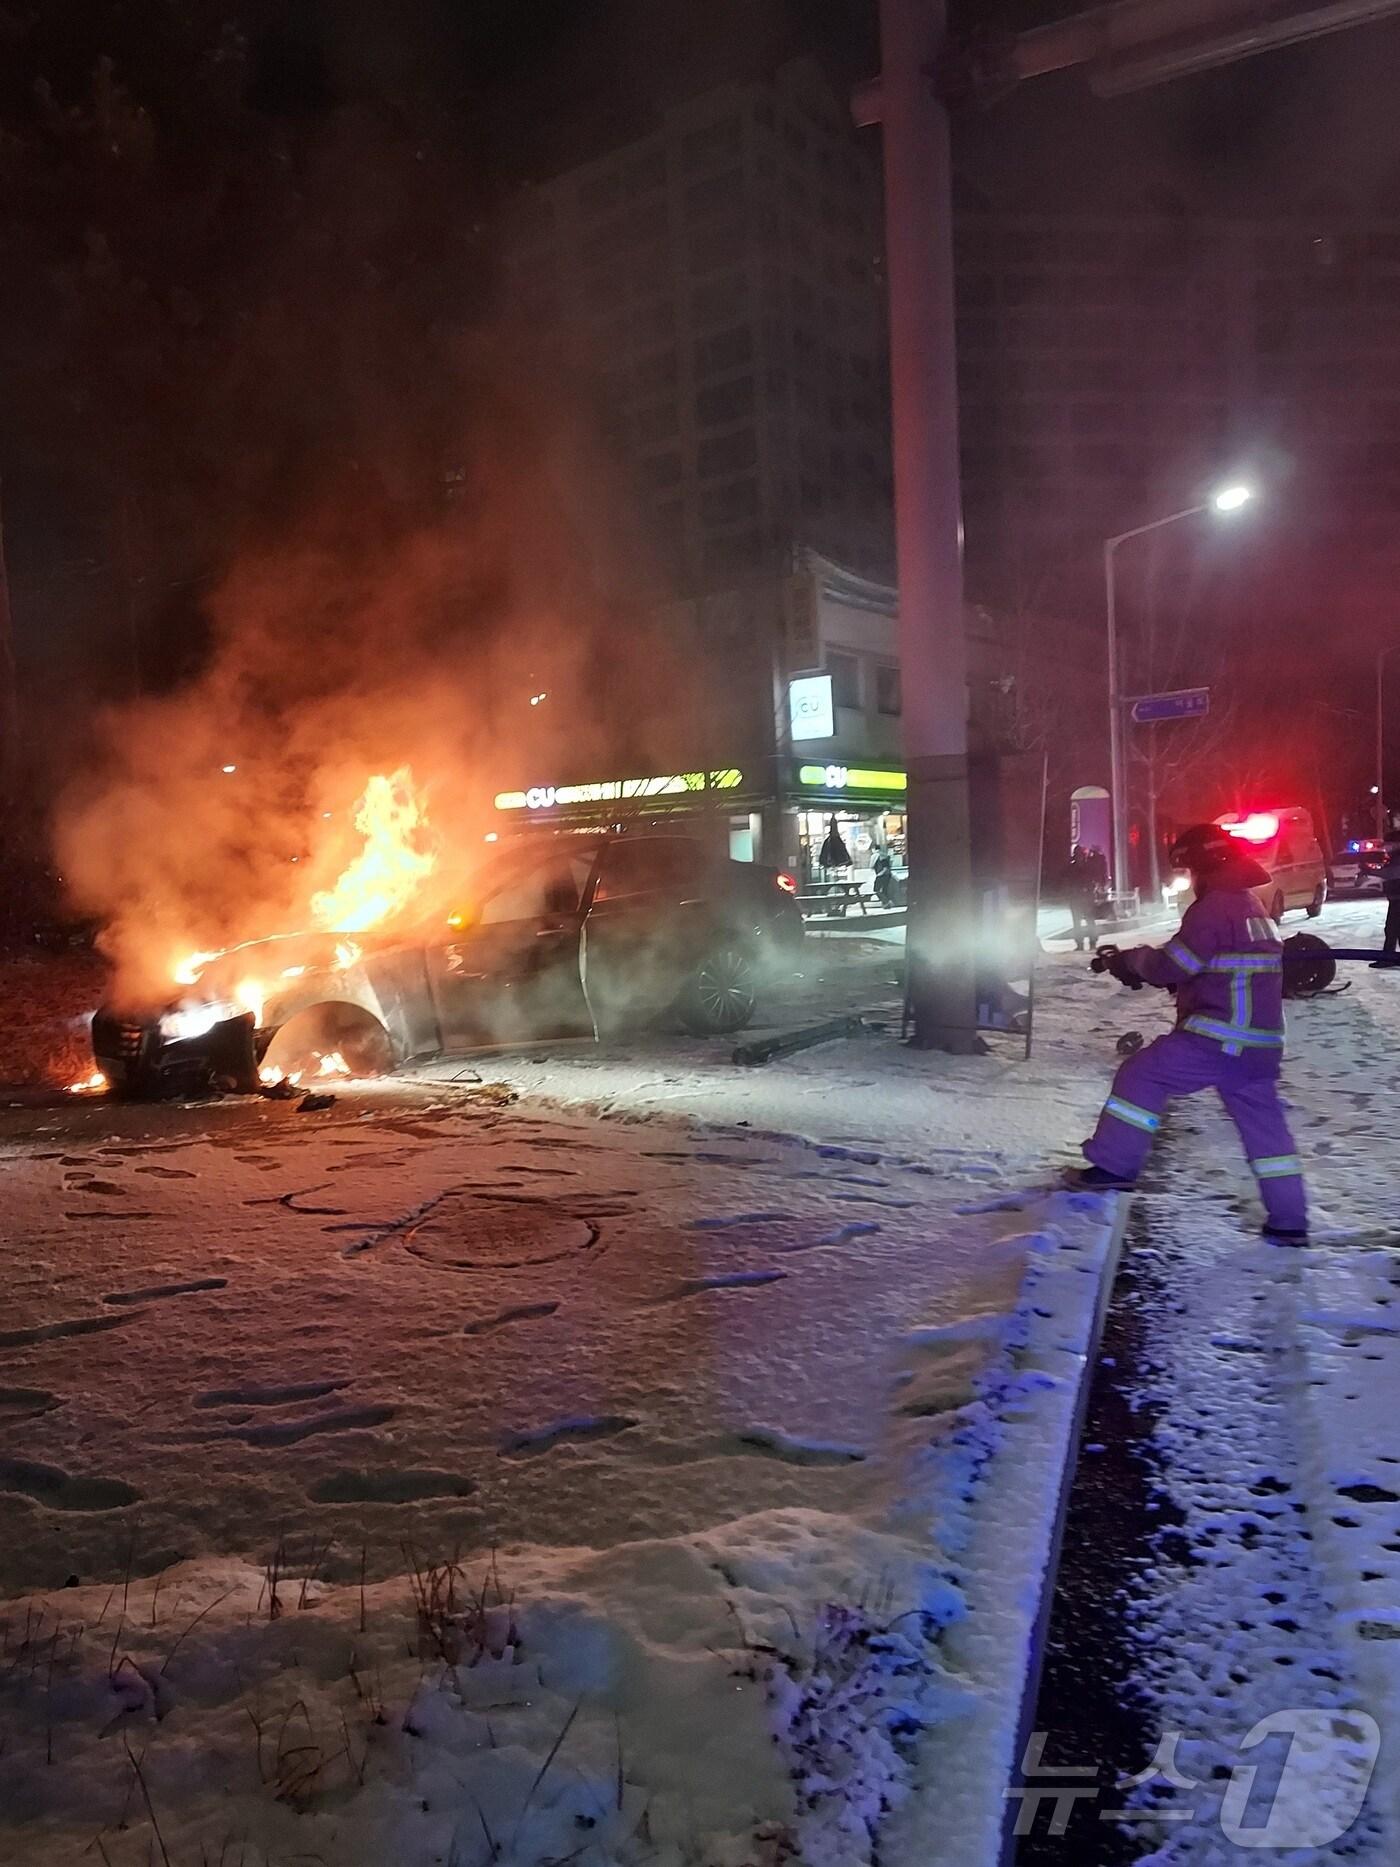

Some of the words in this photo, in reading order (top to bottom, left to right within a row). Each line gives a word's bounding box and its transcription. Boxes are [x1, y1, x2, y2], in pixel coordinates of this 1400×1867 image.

[801, 701, 819, 713] CU
[825, 765, 848, 788] CU
[526, 786, 556, 809] CU
